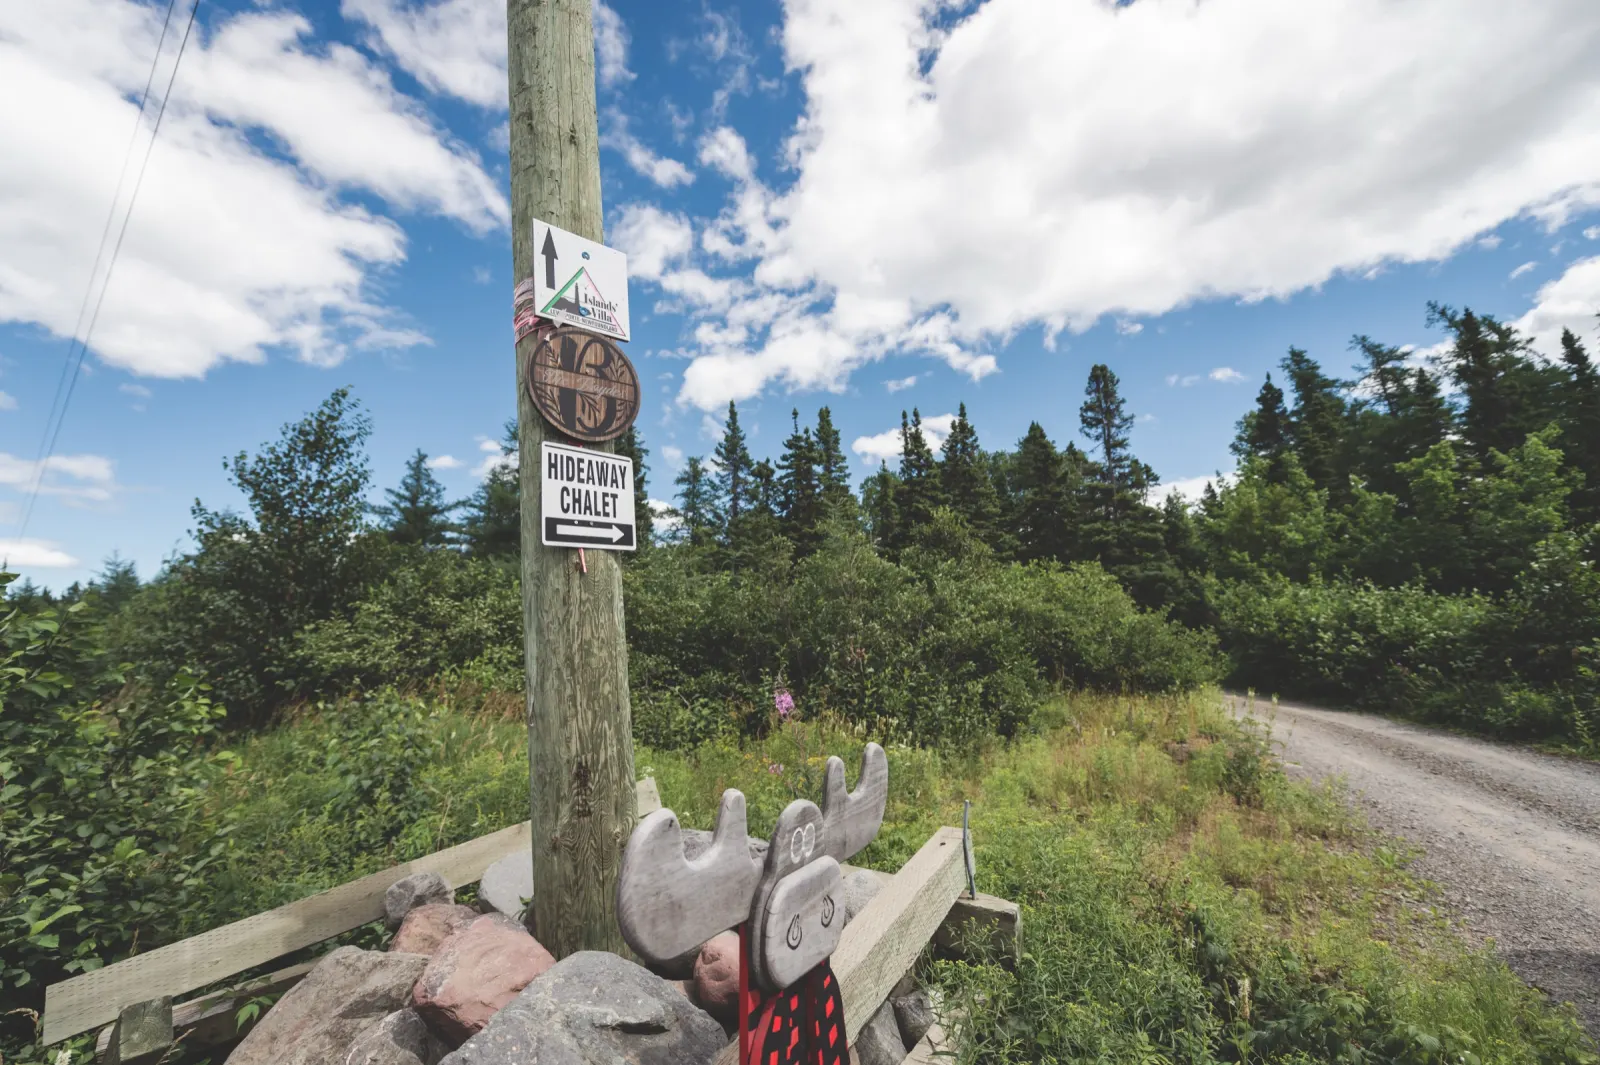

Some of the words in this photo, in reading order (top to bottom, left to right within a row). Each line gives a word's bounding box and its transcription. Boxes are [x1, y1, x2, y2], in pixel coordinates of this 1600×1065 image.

[591, 307, 613, 323] Villa
[548, 452, 627, 490] HIDEAWAY
[560, 486, 619, 519] CHALET
